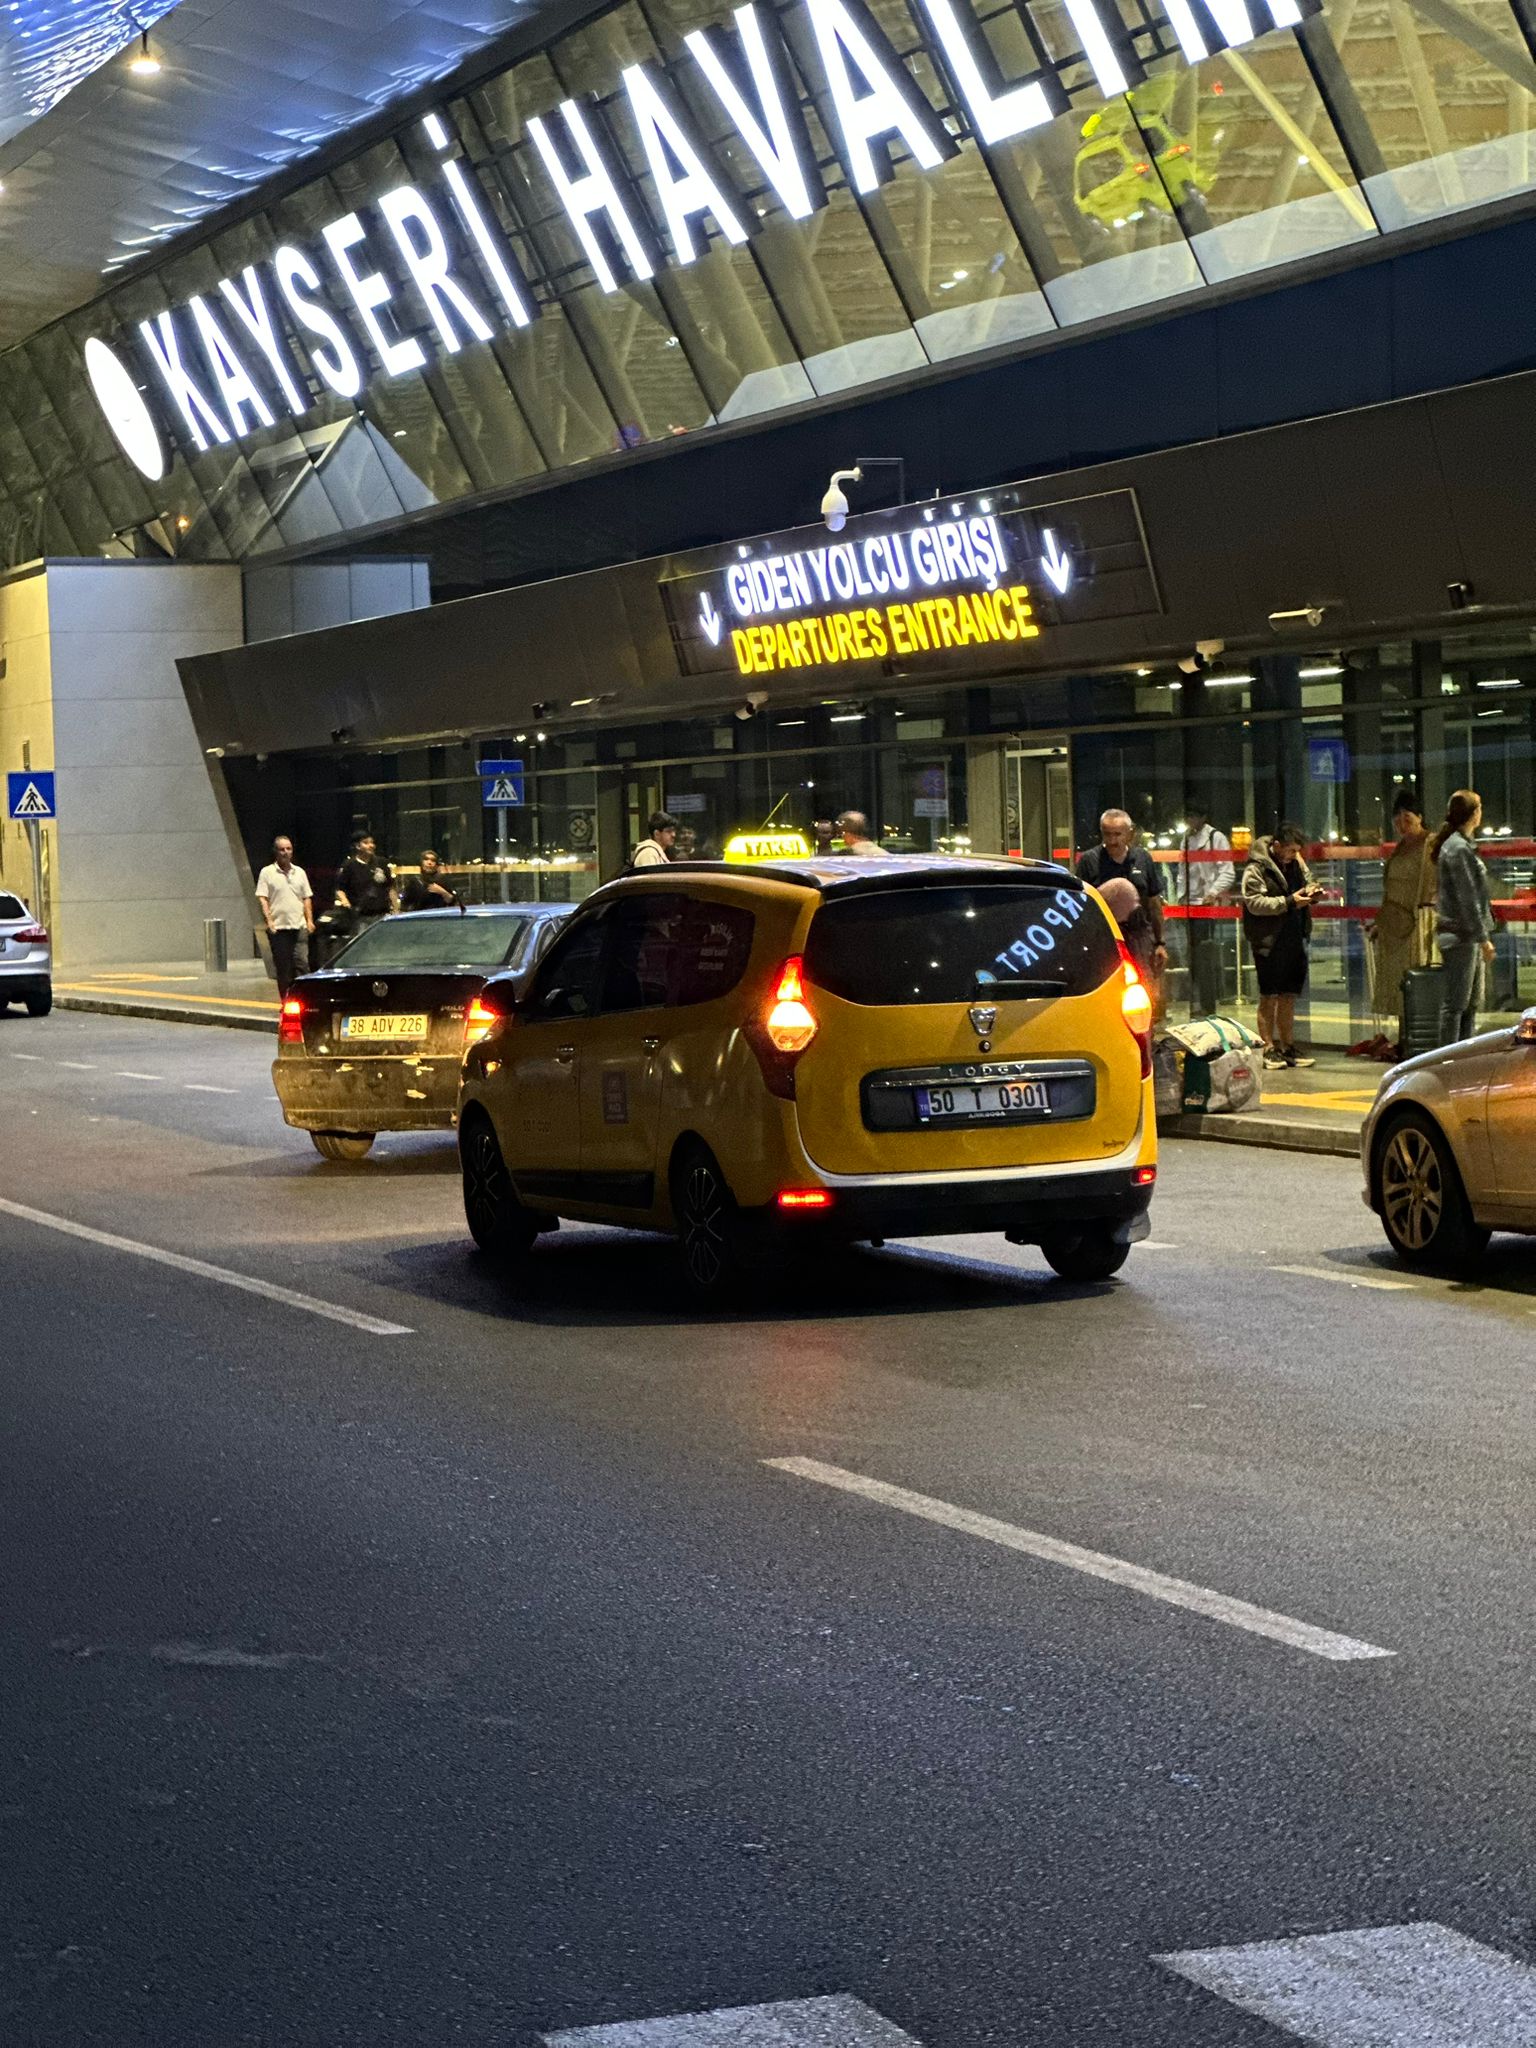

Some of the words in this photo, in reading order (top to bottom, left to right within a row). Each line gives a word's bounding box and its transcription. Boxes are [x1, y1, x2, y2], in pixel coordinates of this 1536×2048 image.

[140, 114, 530, 451] KAYSERİ
[728, 545, 814, 617] GİDEN
[809, 533, 910, 603] YOLCU
[911, 499, 1008, 591] GİRİŞİ
[731, 609, 888, 675] DEPARTURES
[887, 585, 1040, 655] ENTRANCE
[350, 1018, 365, 1034] 38
[371, 1017, 394, 1033] ADV
[400, 1017, 422, 1033] 226
[929, 1089, 956, 1113] 50
[970, 1086, 982, 1110] T
[999, 1083, 1046, 1109] 0301
[948, 1063, 1026, 1078] LODGY
